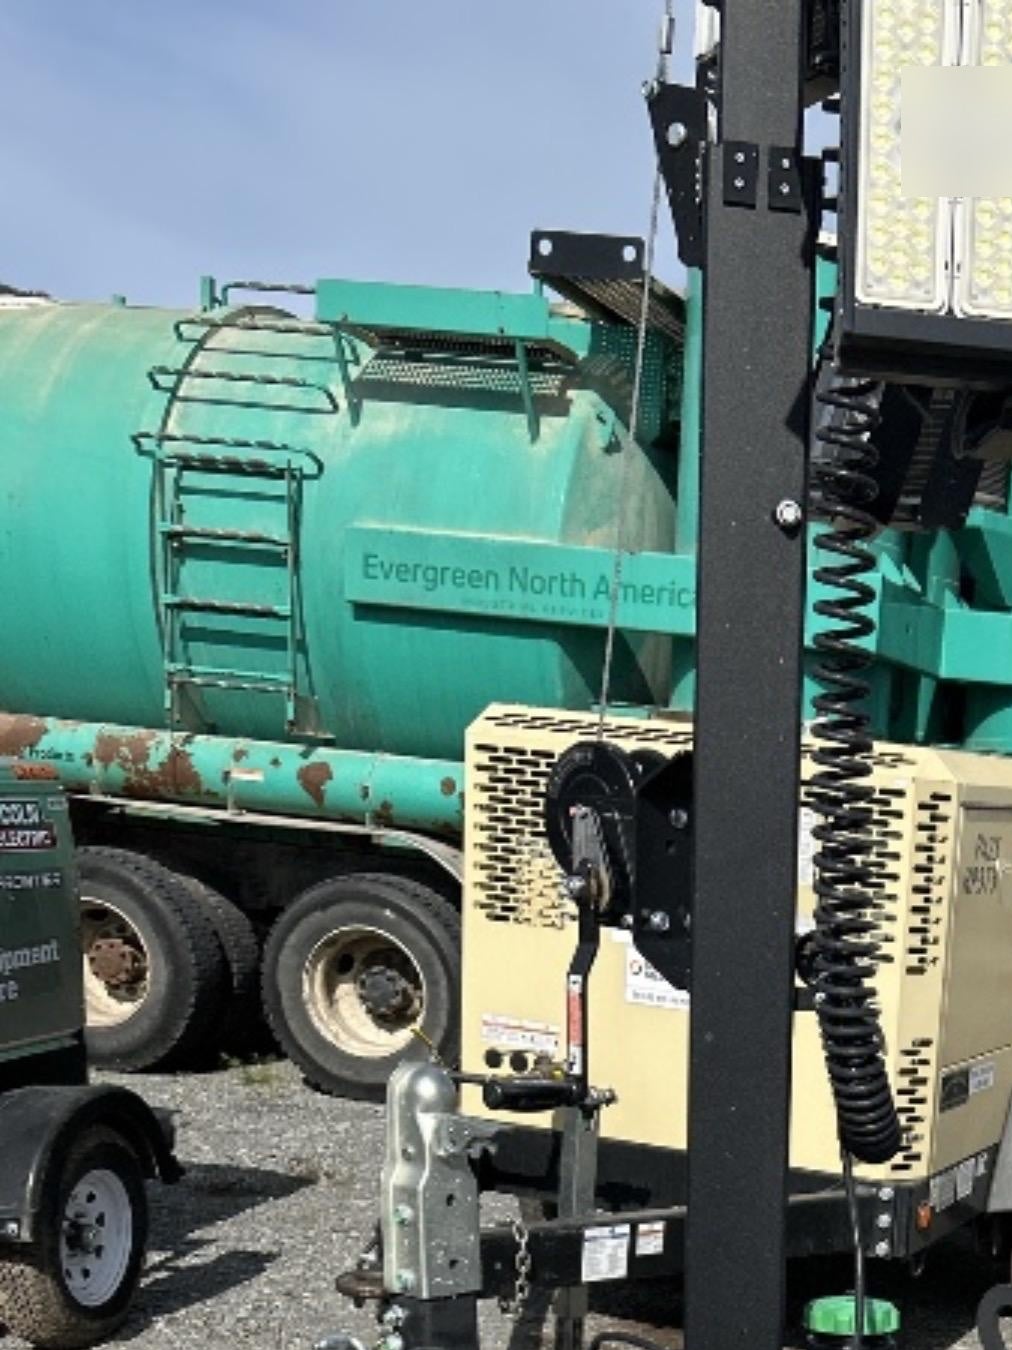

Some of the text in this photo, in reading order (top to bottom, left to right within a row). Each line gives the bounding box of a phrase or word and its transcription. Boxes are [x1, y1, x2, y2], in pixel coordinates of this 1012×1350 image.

[361, 553, 695, 610] Evergreen North Americ
